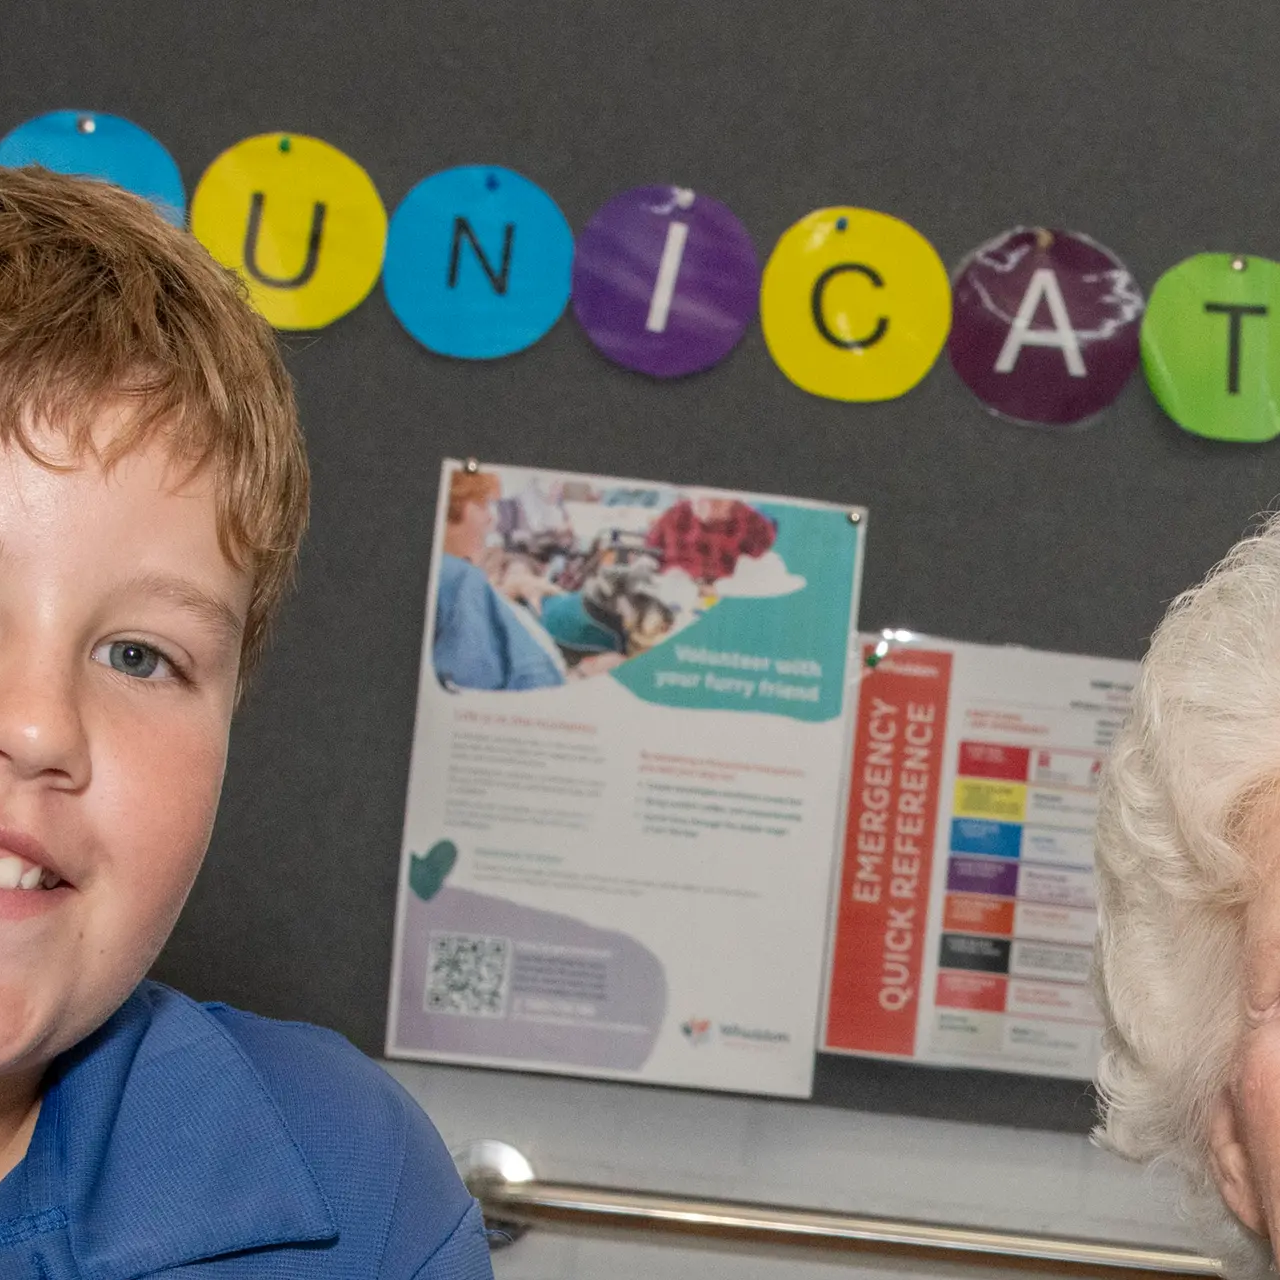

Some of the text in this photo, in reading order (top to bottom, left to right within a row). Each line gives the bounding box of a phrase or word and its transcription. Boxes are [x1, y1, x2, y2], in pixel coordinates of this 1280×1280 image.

[656, 670, 702, 688] your
[758, 679, 819, 702] friend
[775, 658, 822, 677] with
[853, 698, 898, 903] EMERGENCY
[890, 702, 935, 899] REFERENCE
[878, 906, 915, 1011] QUICK
